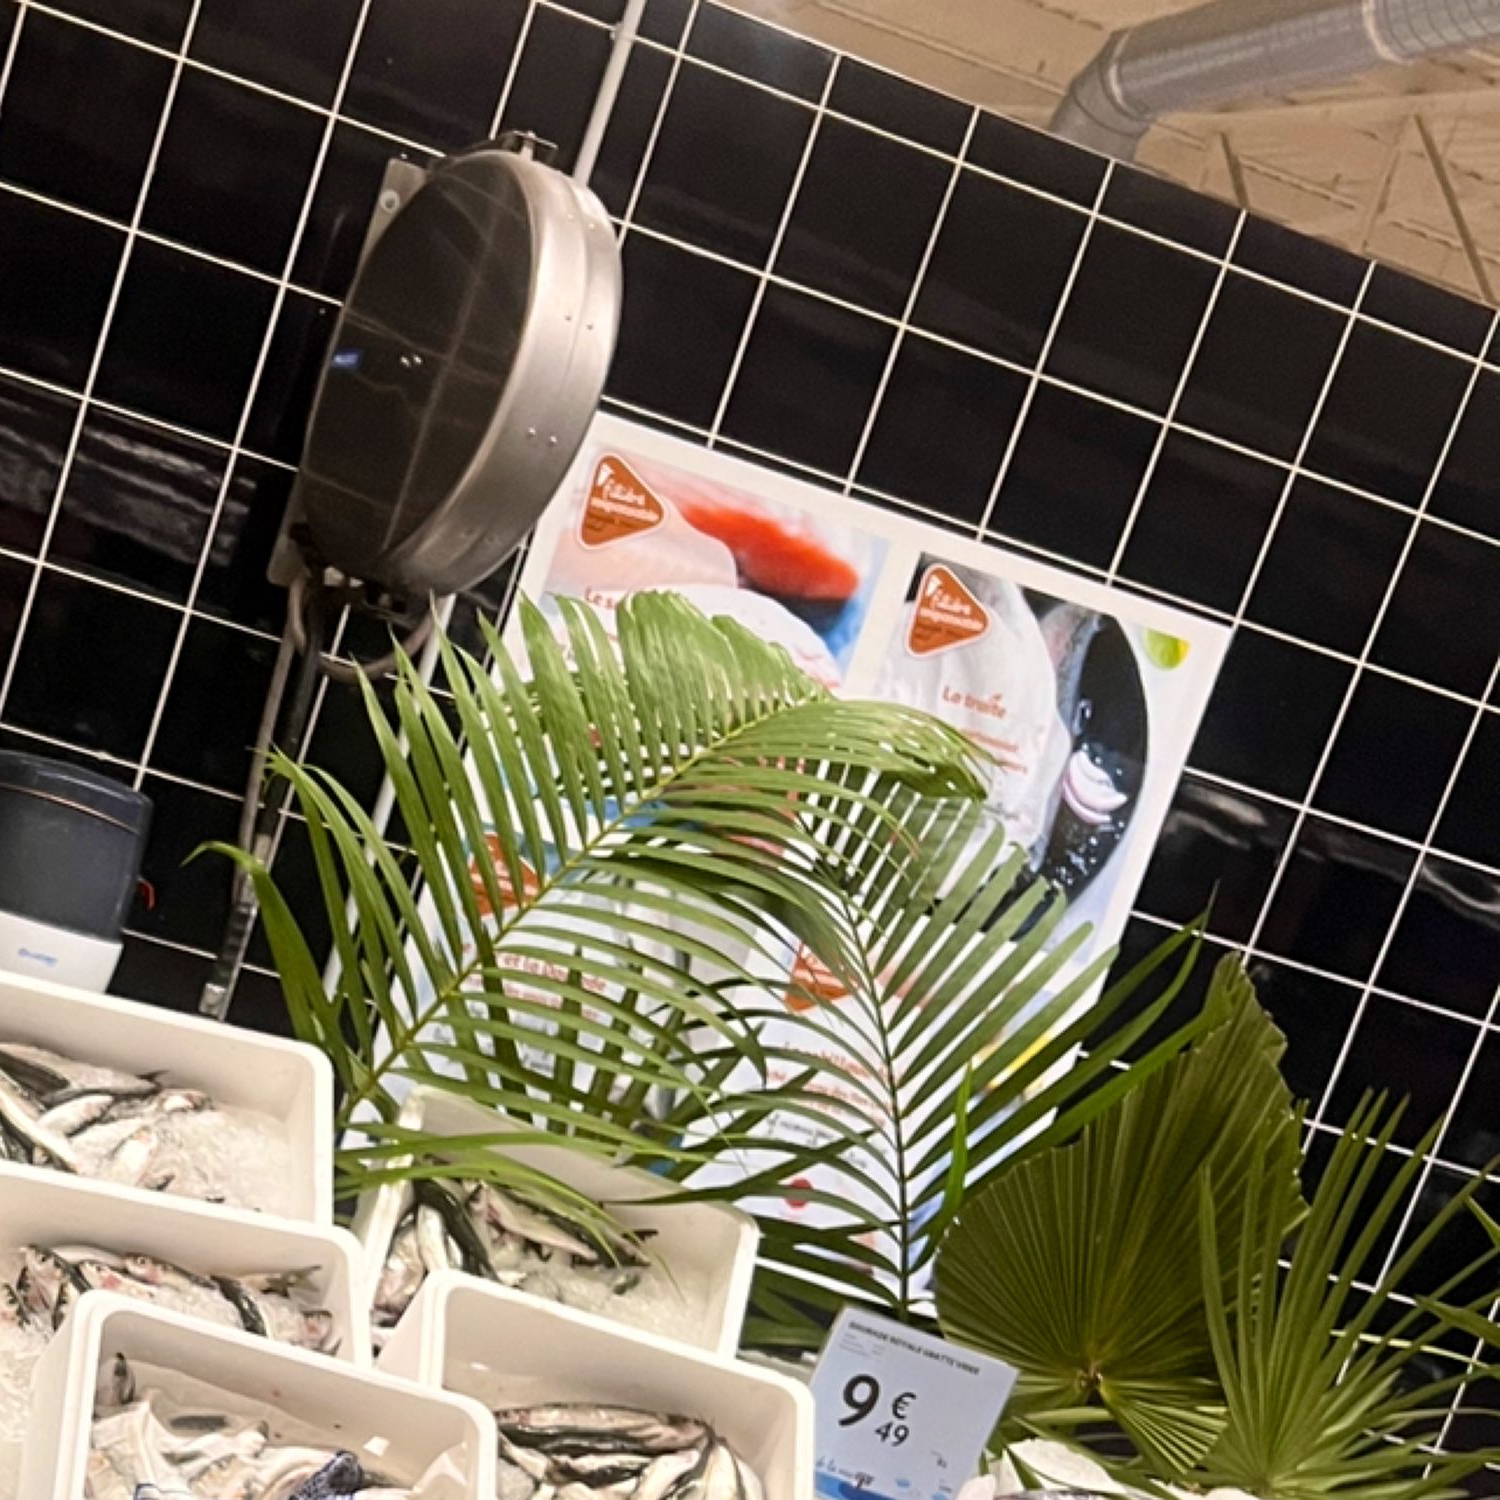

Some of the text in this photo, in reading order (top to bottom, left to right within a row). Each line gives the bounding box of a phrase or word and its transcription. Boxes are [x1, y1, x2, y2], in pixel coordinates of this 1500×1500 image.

[838, 1373, 918, 1447] 9 € 49
